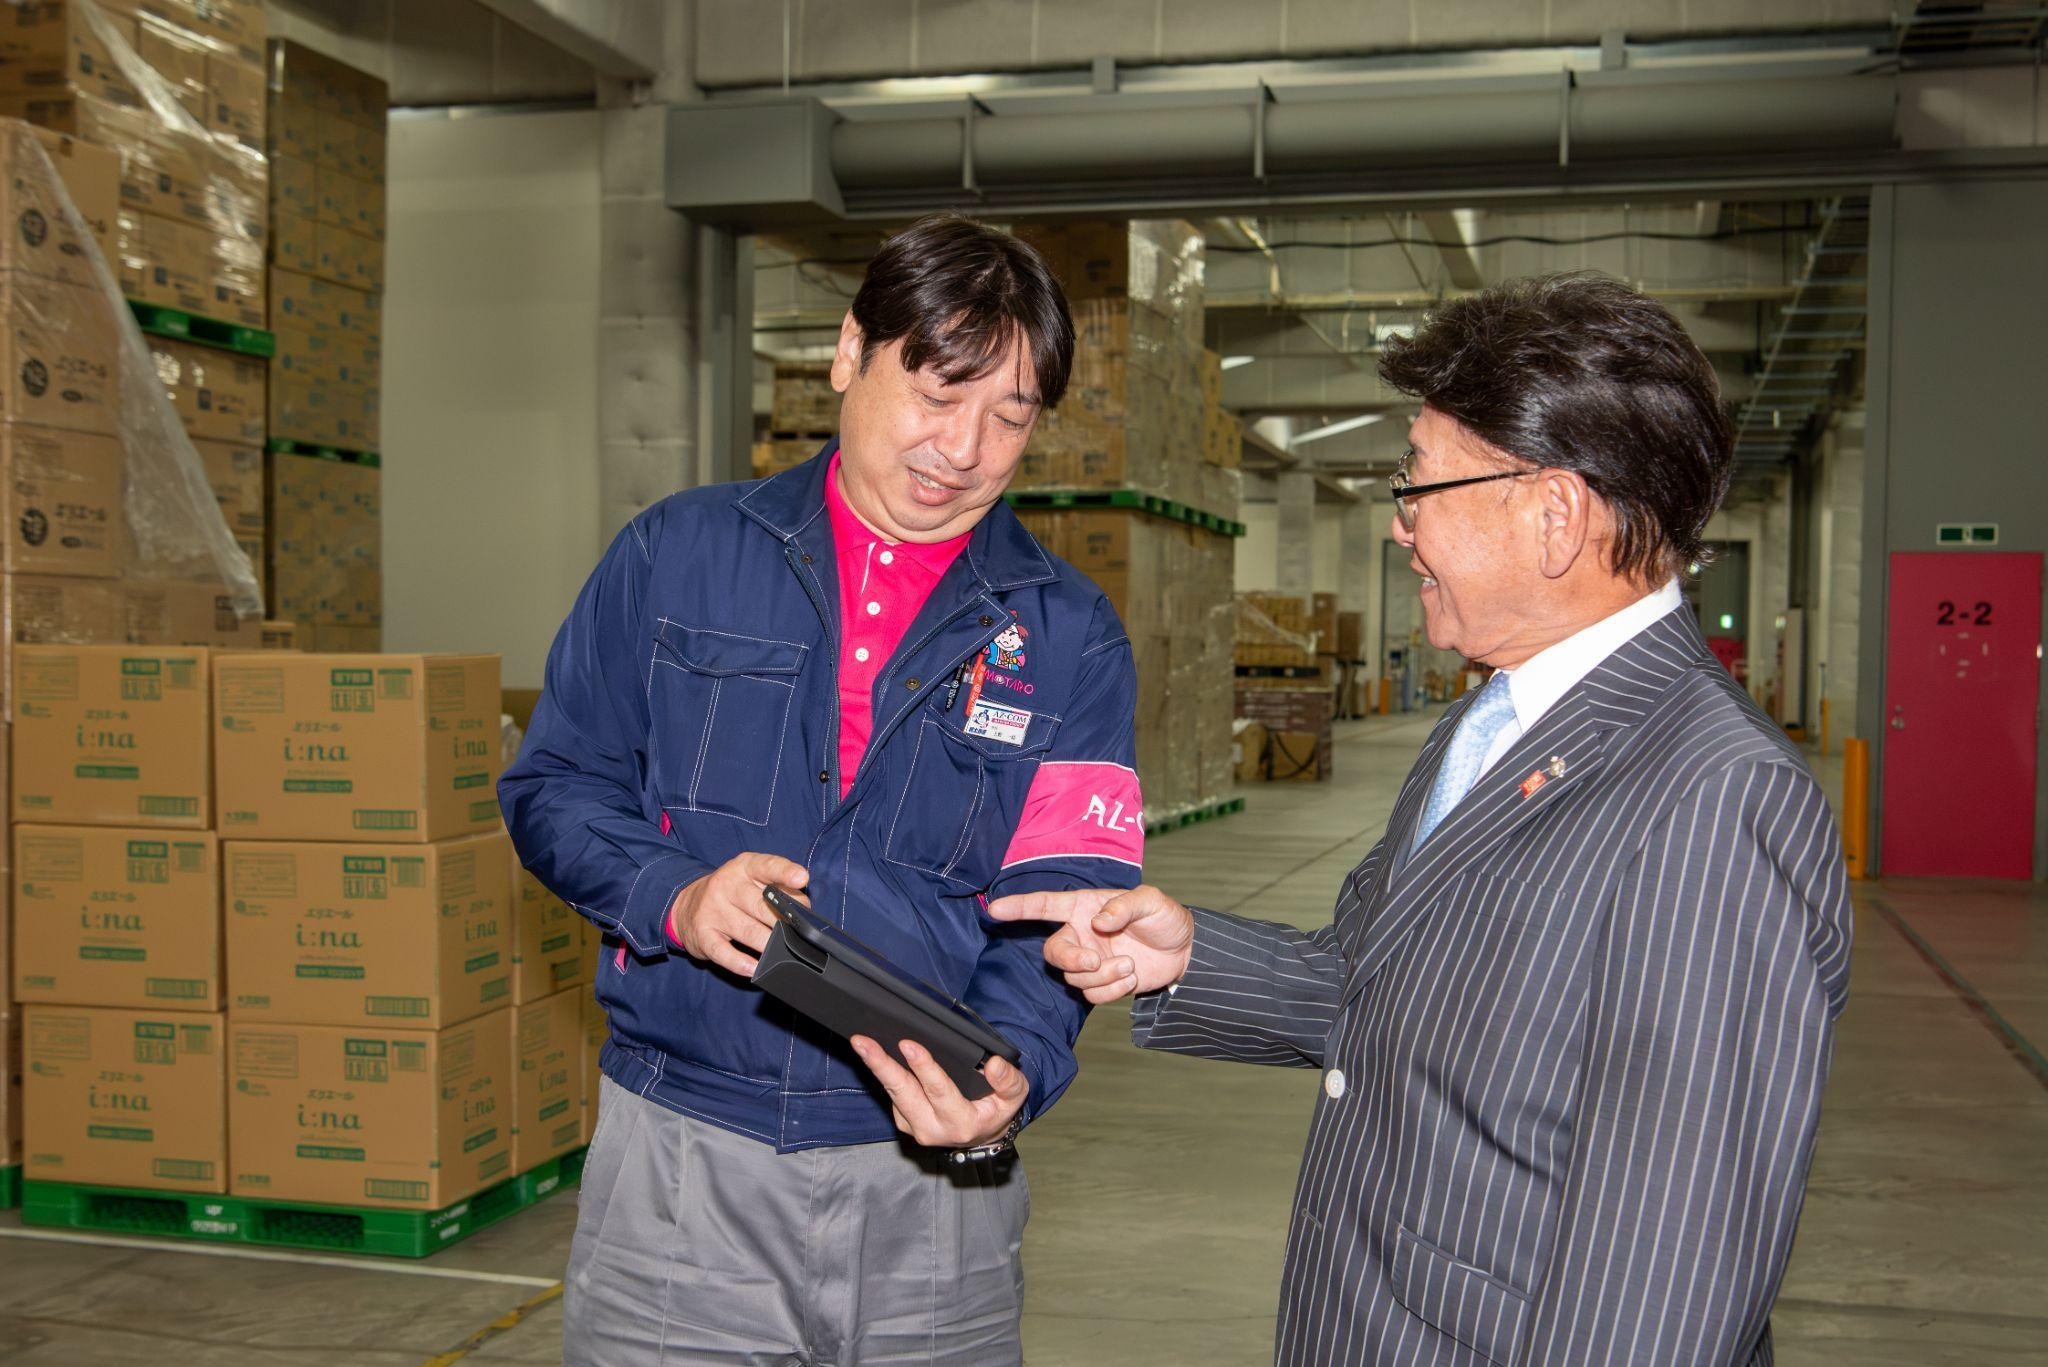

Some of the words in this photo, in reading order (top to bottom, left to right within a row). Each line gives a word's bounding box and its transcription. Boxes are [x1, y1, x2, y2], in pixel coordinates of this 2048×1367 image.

[1937, 601, 1993, 625] 2-2
[76, 723, 137, 749] i:na
[283, 737, 350, 761] i:na
[81, 905, 145, 931] i:na
[296, 923, 363, 948] i:na
[89, 1085, 152, 1111] i:na
[297, 1103, 363, 1130] i:na
